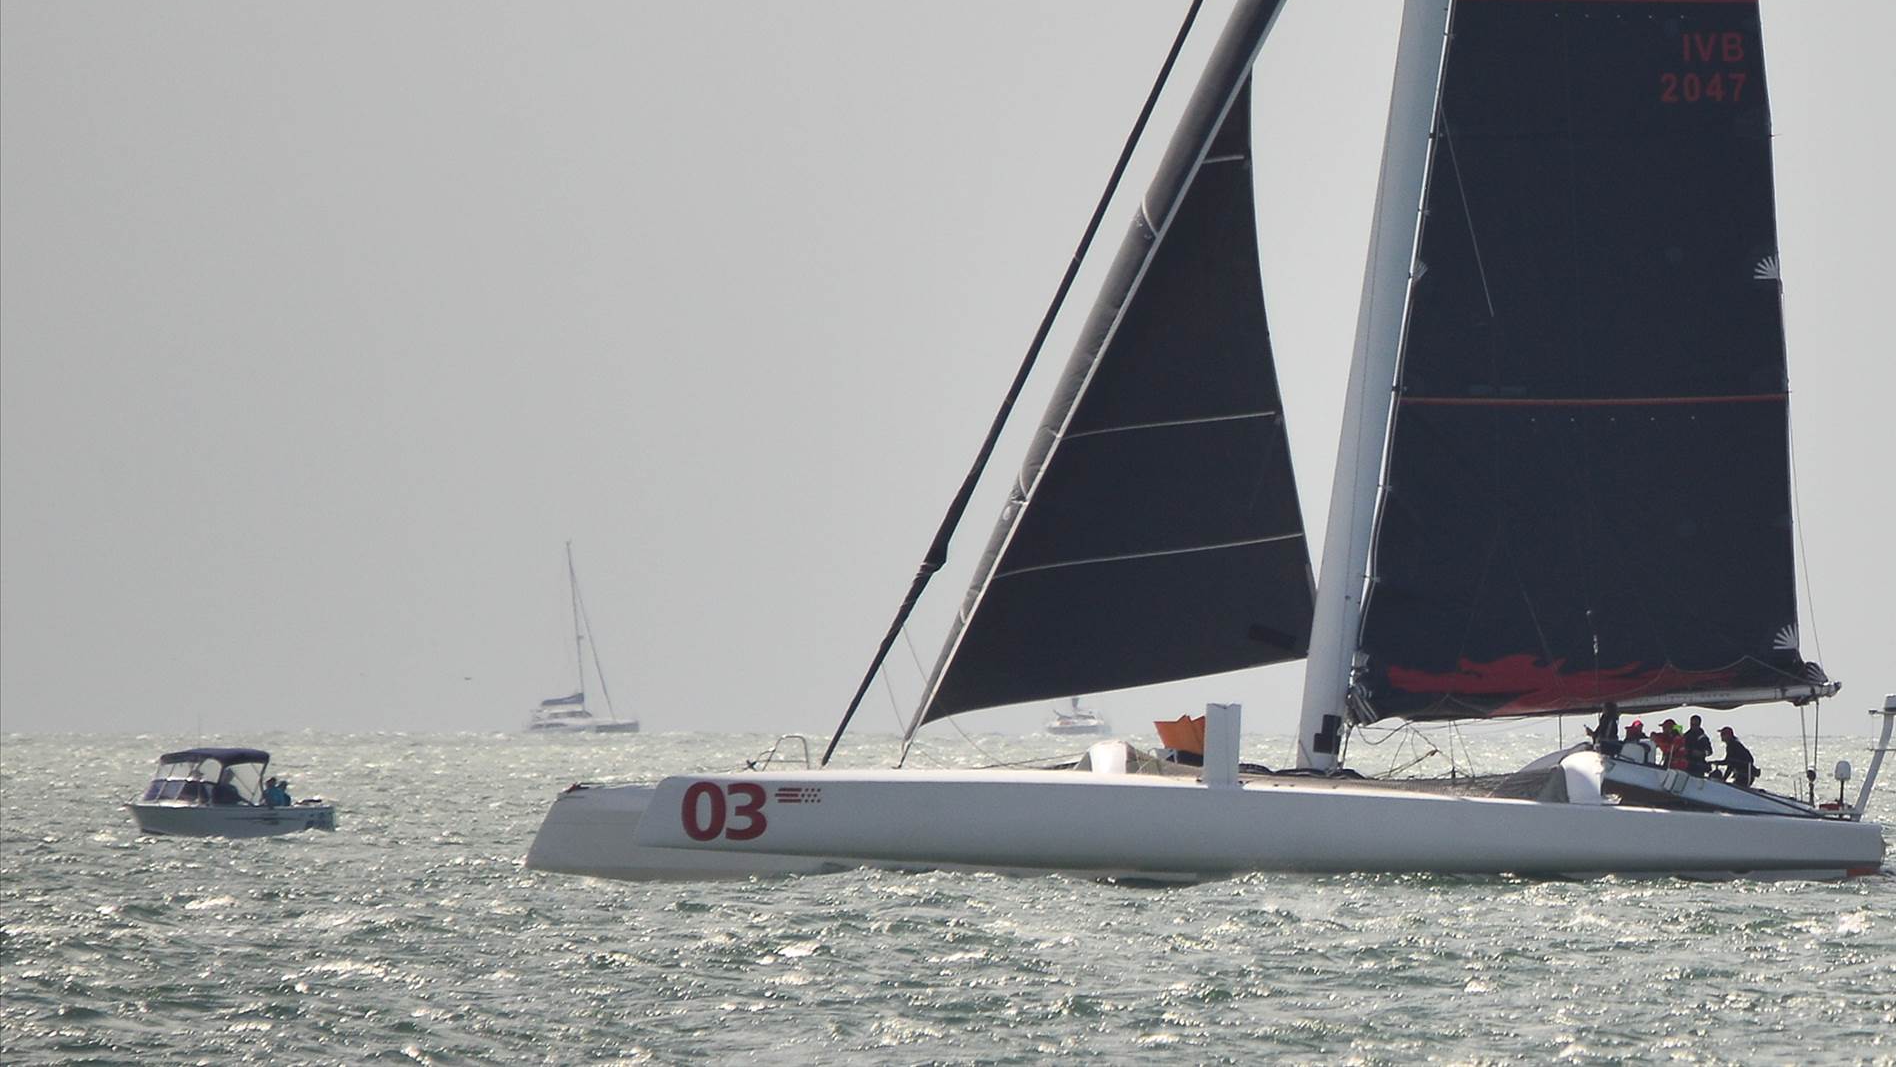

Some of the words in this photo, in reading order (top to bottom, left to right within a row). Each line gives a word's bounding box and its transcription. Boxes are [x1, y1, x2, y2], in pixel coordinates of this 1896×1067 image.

[1683, 32, 1744, 62] IVB
[1661, 72, 1746, 102] 2047
[681, 781, 767, 841] 03
